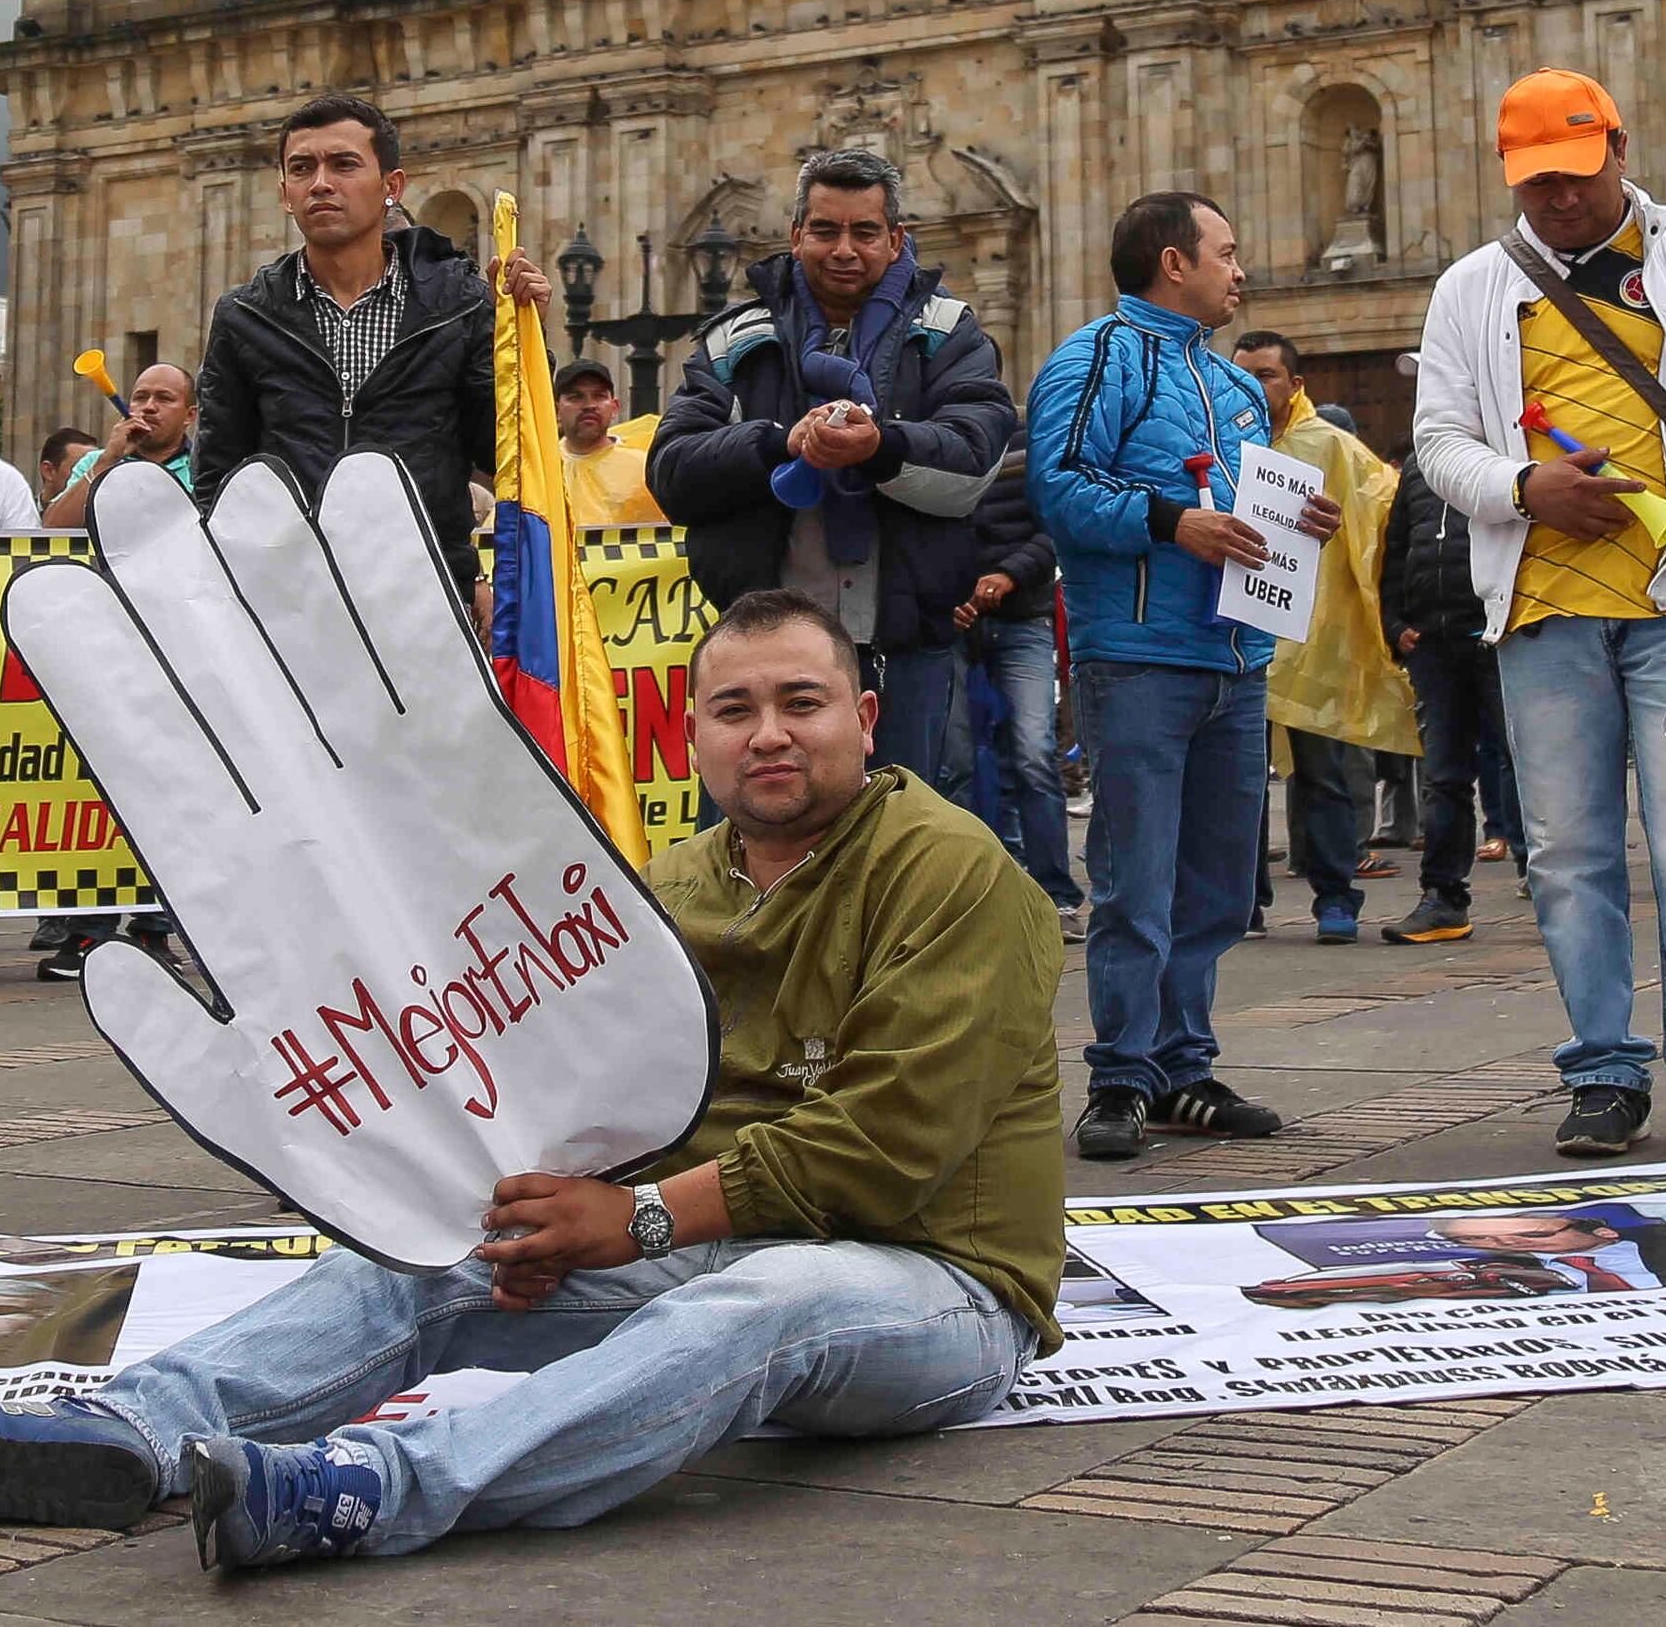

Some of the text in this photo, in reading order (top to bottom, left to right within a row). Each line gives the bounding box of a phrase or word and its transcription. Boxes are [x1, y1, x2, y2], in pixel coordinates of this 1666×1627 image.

[1256, 466, 1286, 489] NOS
[1243, 574, 1294, 612] UBER
[1200, 1200, 1285, 1220] EN
[1285, 1198, 1360, 1215] EL
[1359, 1311, 1437, 1323] Dio
[1444, 1298, 1656, 1319] concepto
[1276, 1317, 1531, 1342] ILEGALIDAD
[1535, 1313, 1597, 1327] en
[1603, 1308, 1652, 1321] el
